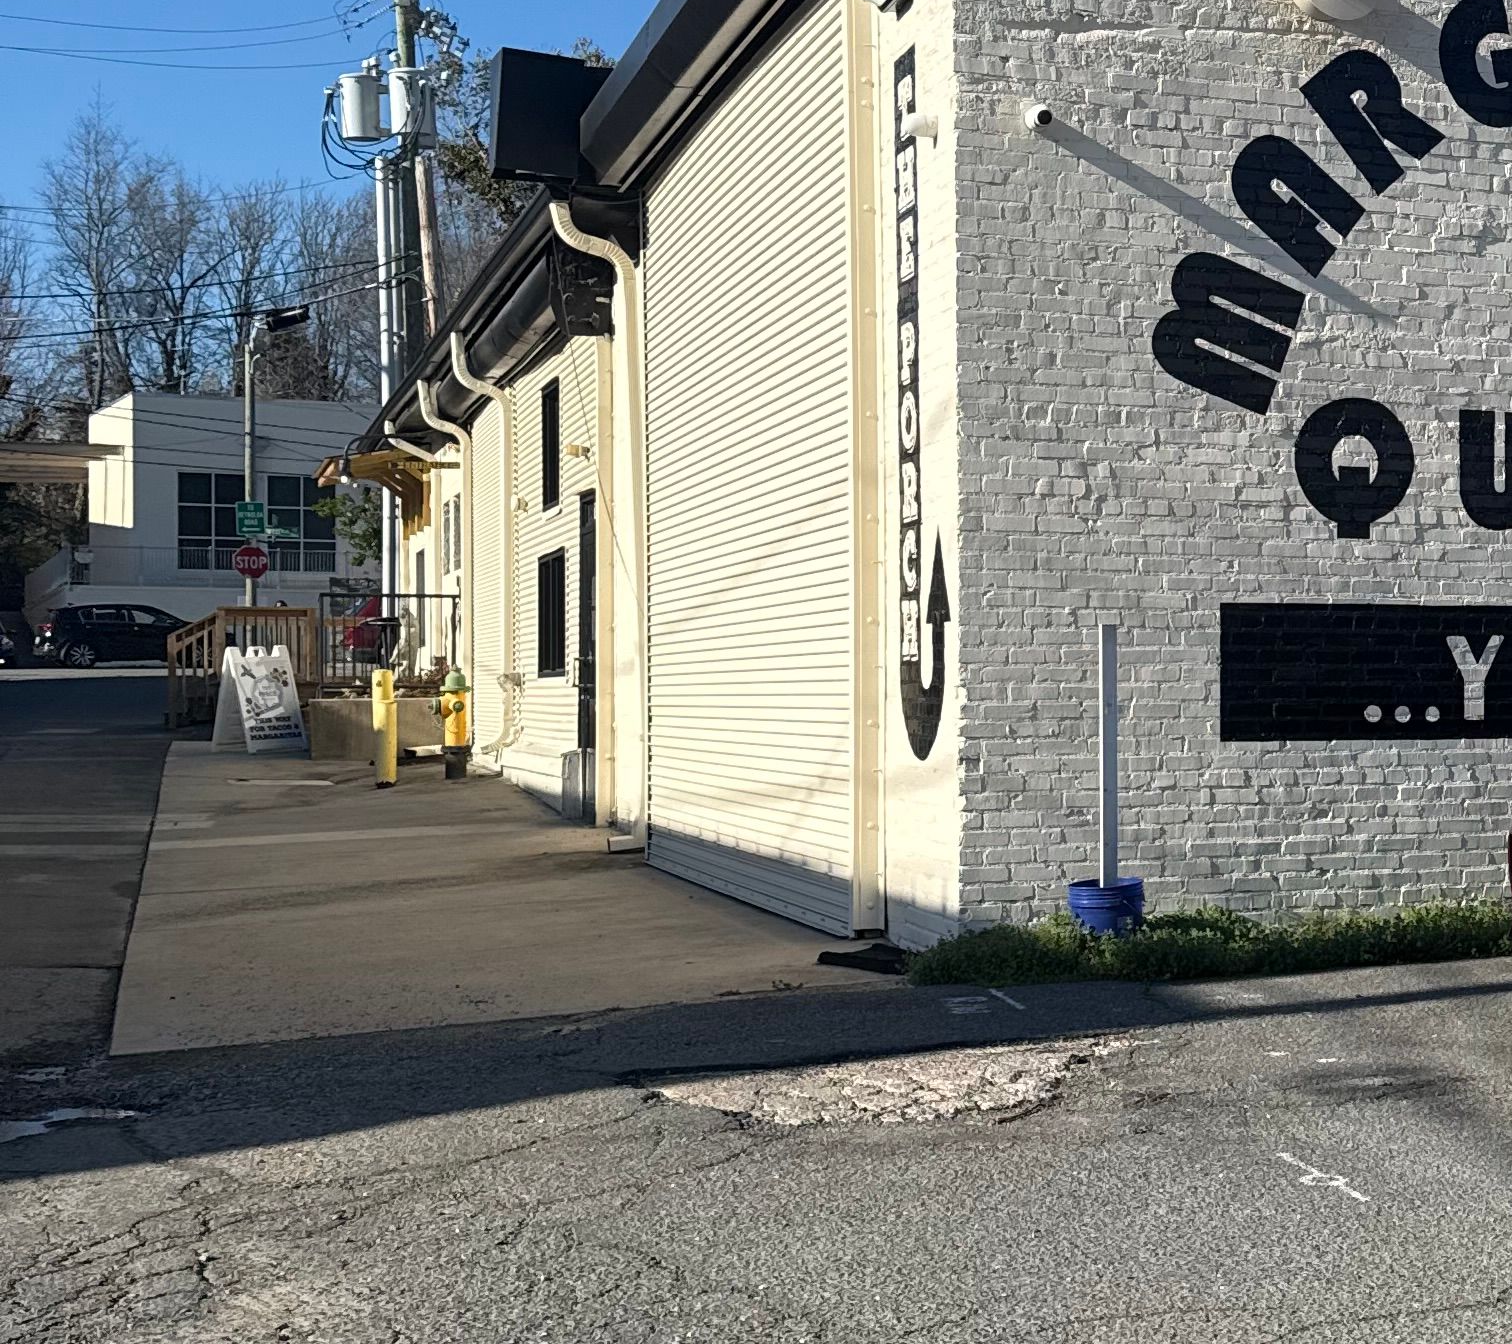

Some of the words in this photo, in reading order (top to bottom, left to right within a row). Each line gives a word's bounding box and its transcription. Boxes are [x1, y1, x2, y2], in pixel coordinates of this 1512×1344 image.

[896, 74, 916, 283] THE
[236, 556, 267, 569] STOP
[900, 321, 919, 662] PORCH
